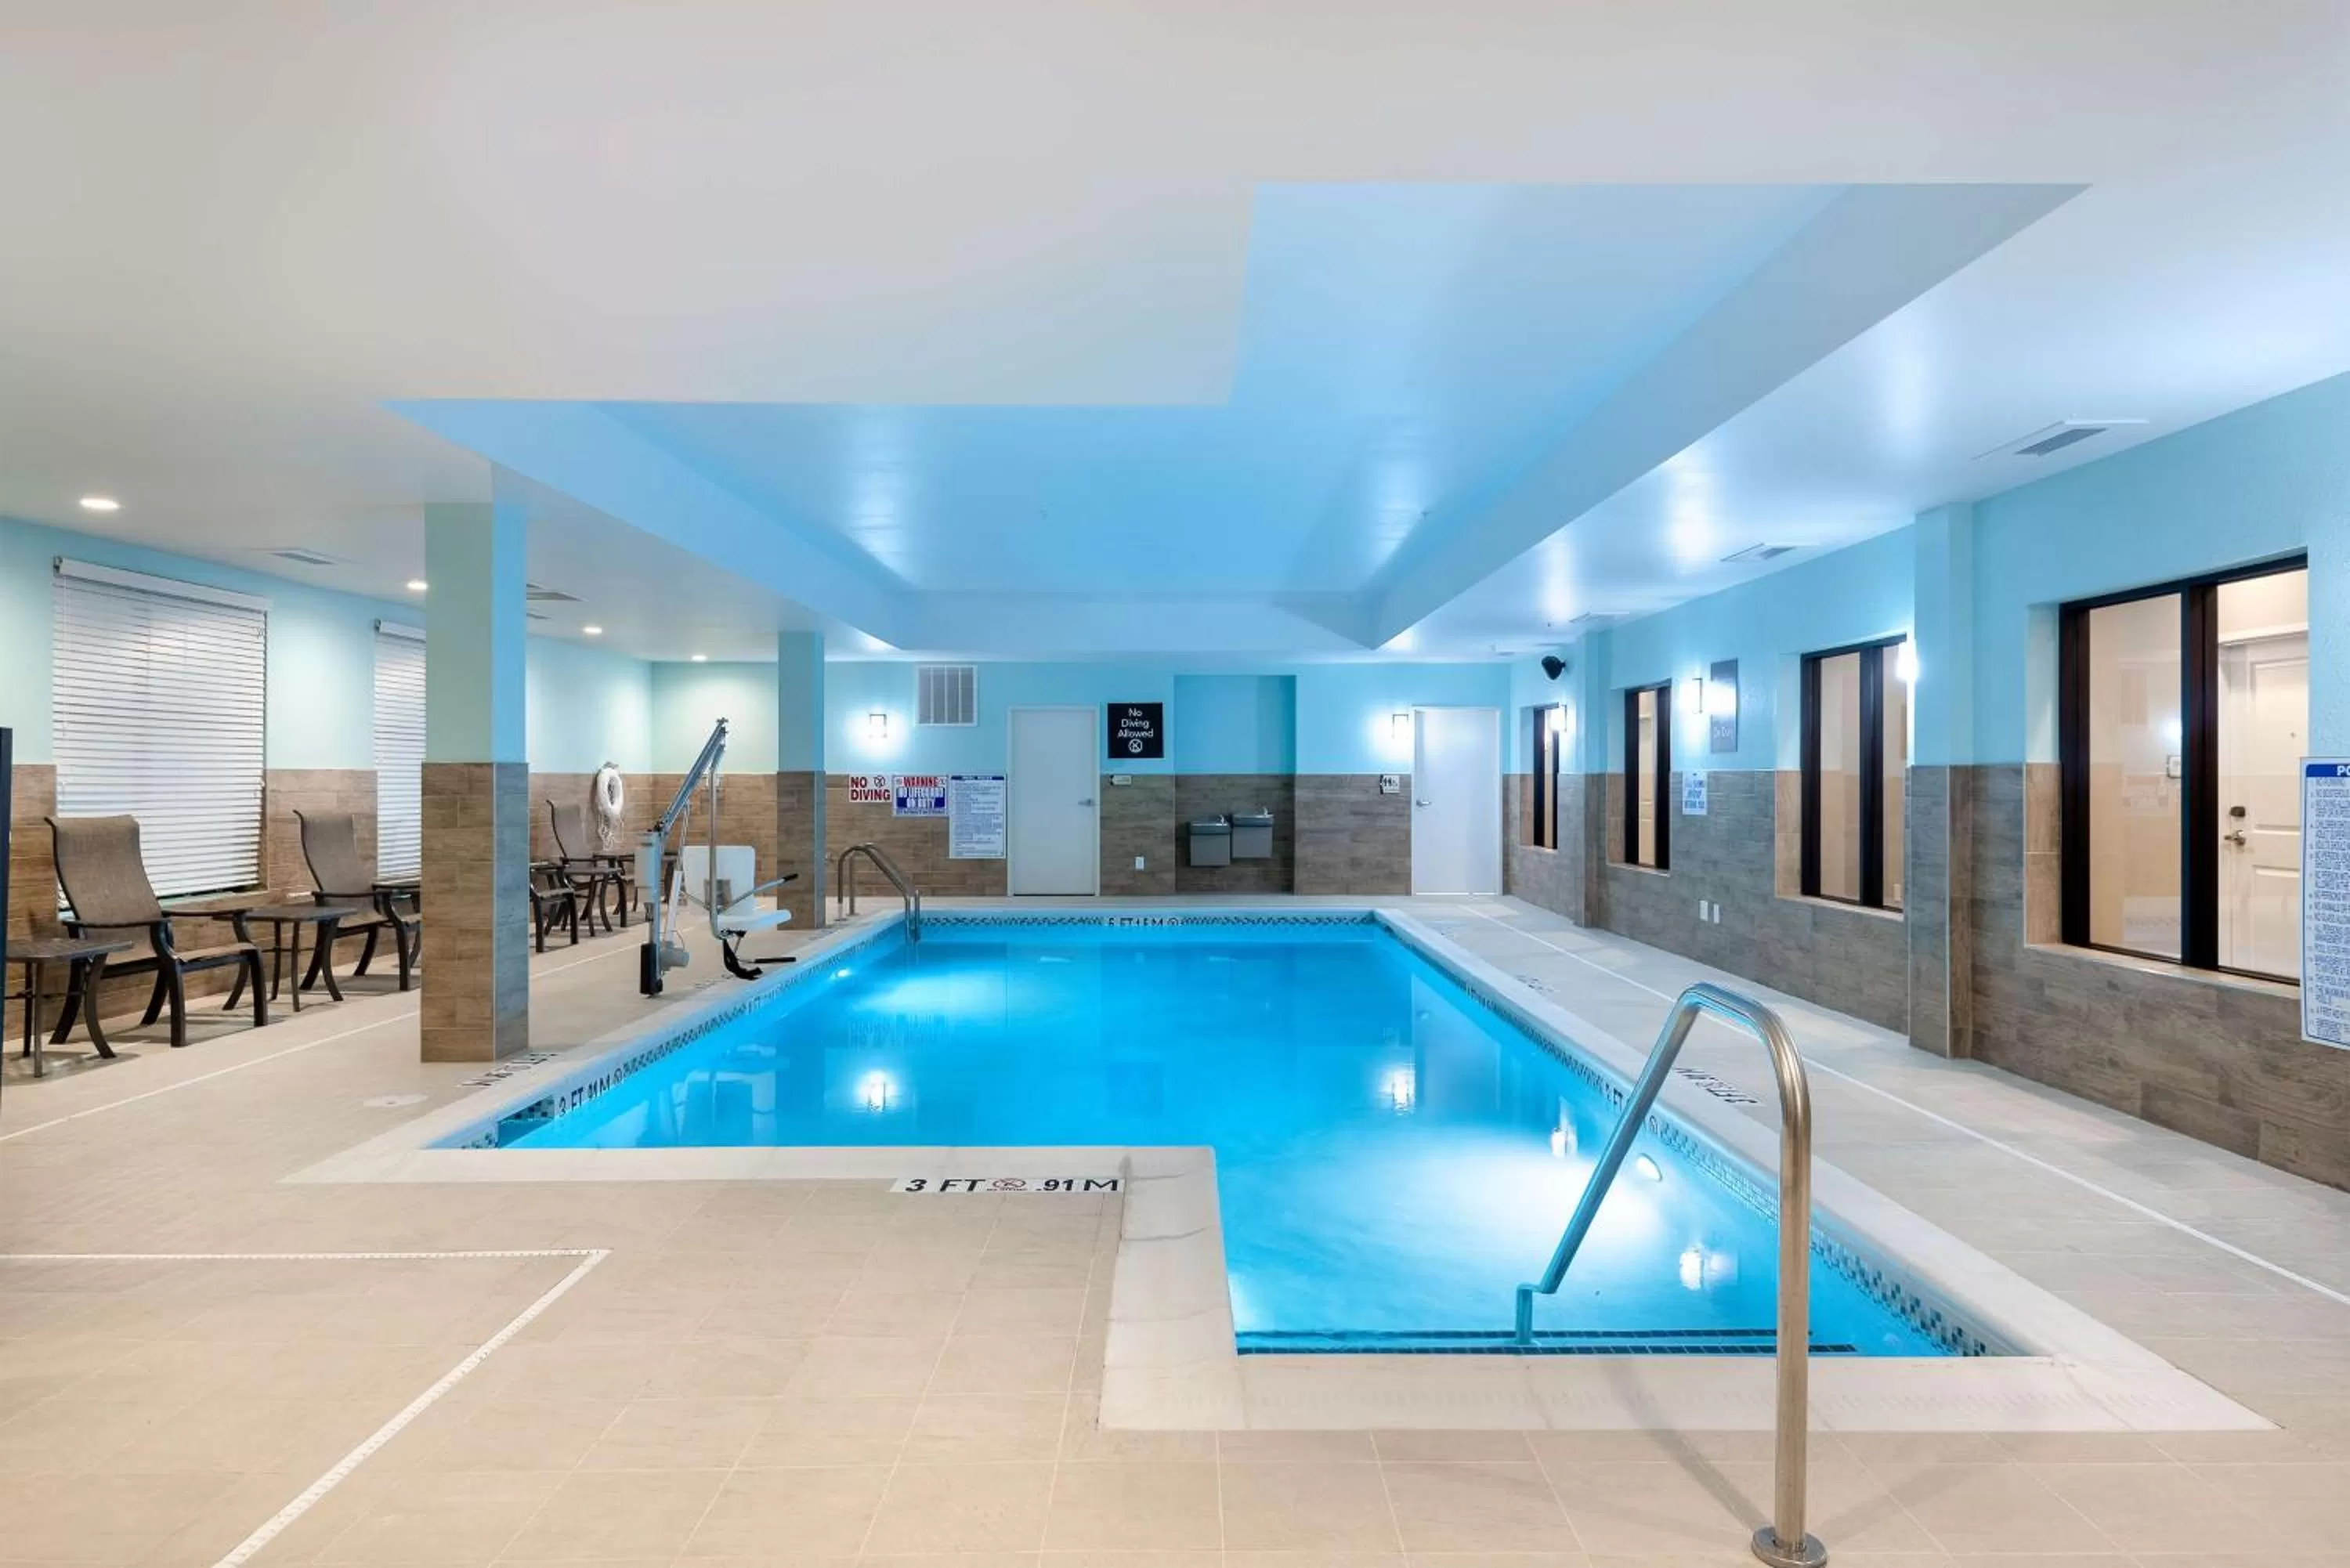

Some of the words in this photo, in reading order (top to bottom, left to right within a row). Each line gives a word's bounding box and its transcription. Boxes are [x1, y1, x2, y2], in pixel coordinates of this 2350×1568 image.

[1128, 707, 1143, 717] No
[1121, 718, 1150, 728] Diving
[1117, 728, 1154, 738] Allowed
[851, 776, 867, 788] NO
[851, 789, 891, 800] DIVING
[571, 1086, 584, 1111] FT
[905, 1179, 927, 1191] 3
[940, 1179, 986, 1191] FT
[1083, 1179, 1119, 1191] M
